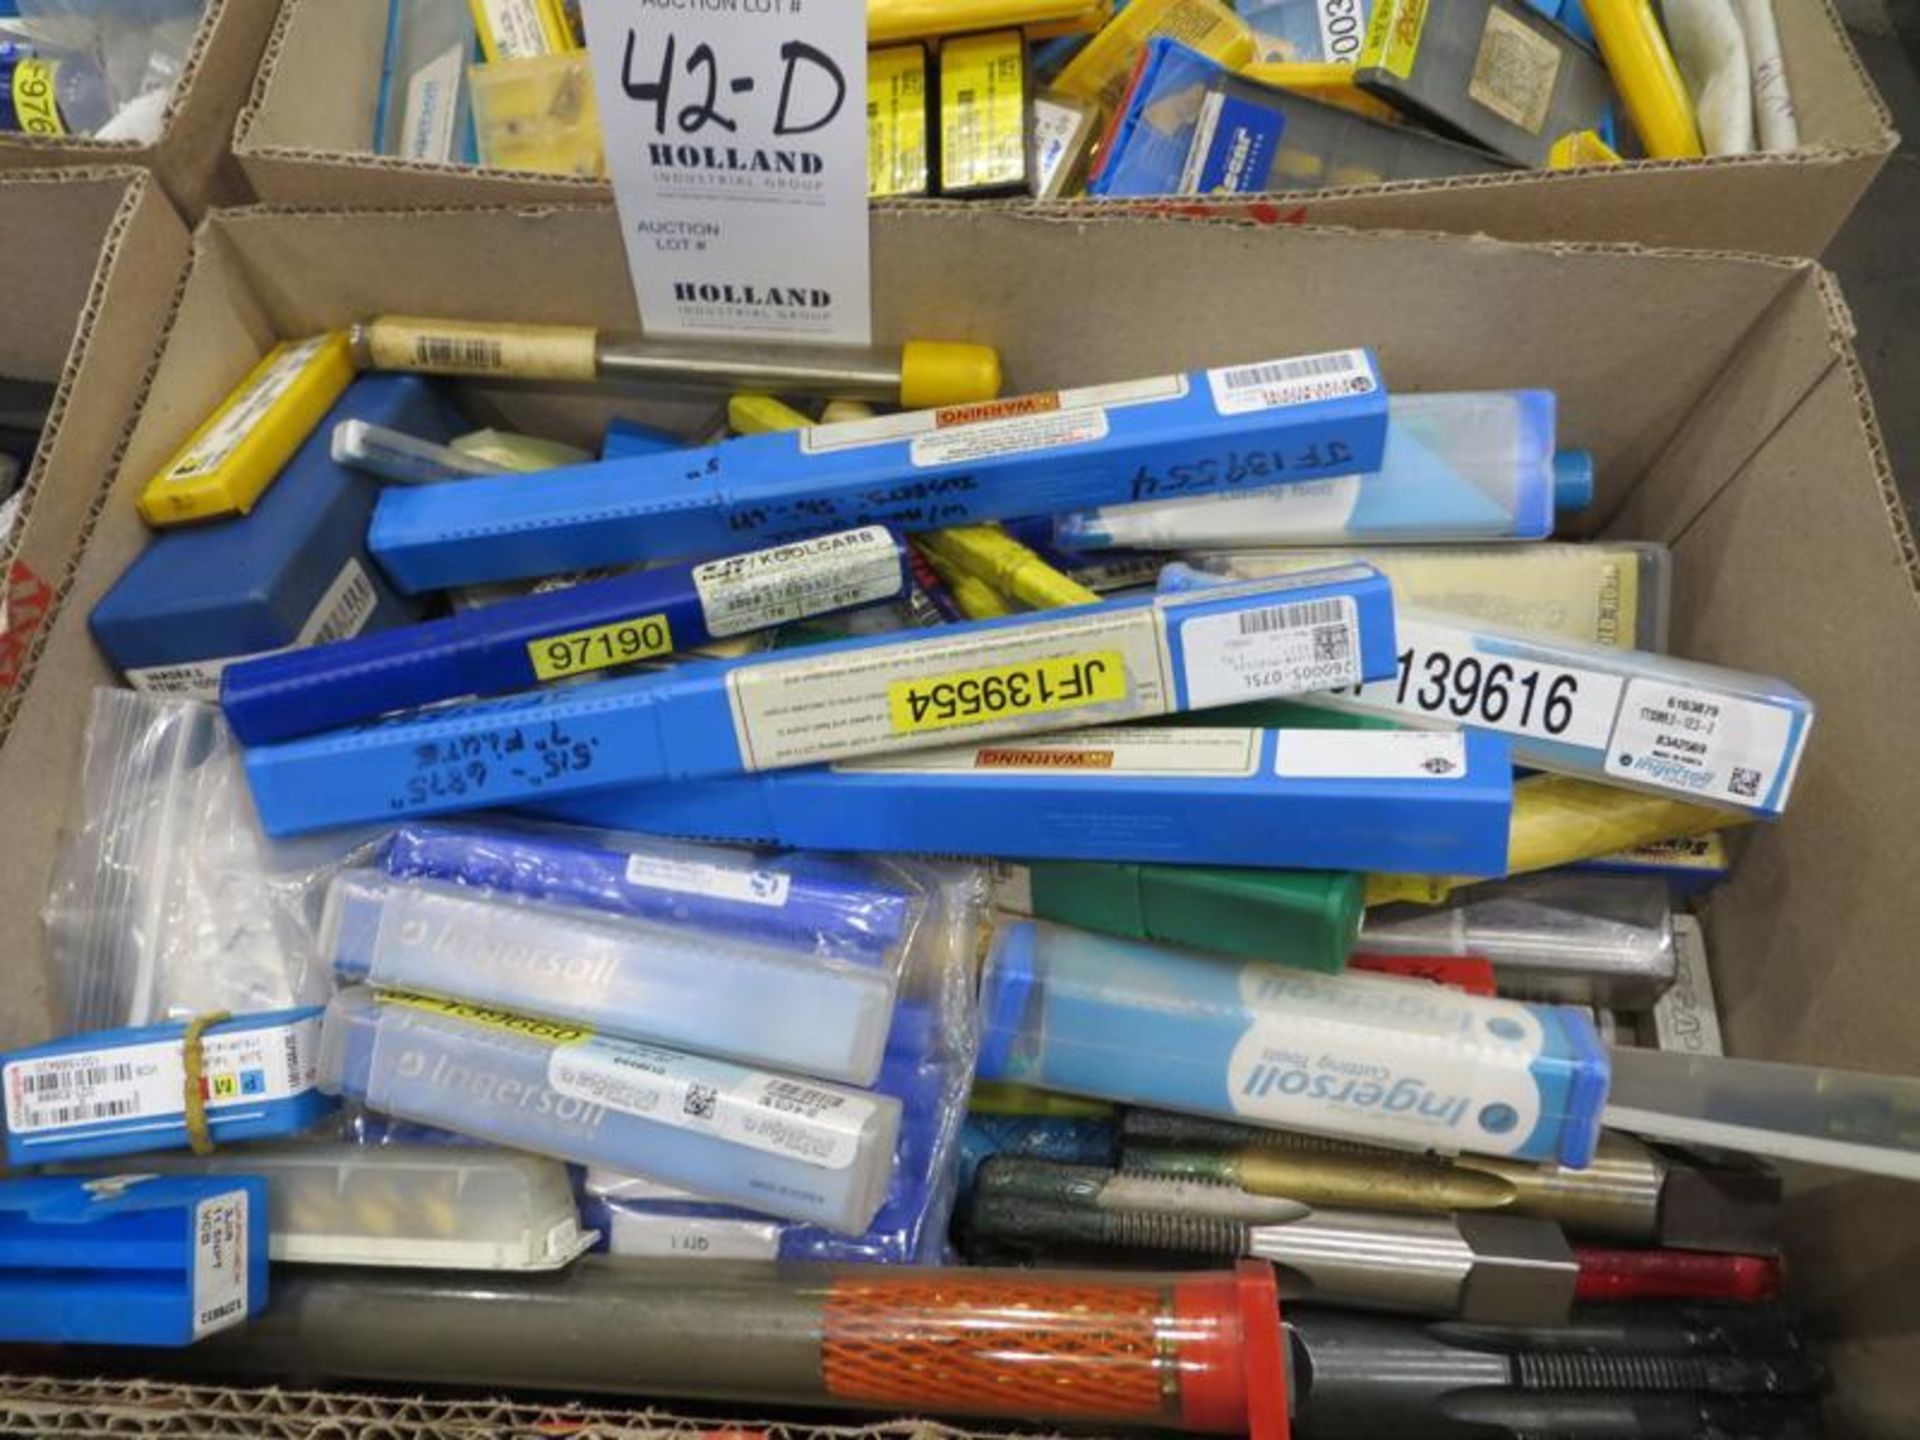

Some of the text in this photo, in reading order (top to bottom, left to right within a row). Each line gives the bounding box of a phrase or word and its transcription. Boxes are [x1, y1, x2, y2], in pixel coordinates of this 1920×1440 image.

[621, 28, 846, 136] 42-D
[648, 143, 823, 175] HOLLAND
[654, 172, 824, 192] INDUSTRIAL GROUP
[637, 220, 720, 237] AUCTION
[655, 237, 707, 251] LOT #
[673, 282, 832, 309] HOLLAND
[678, 304, 832, 322] INDUSTRIAL GROUP
[939, 400, 1037, 427] WARNING
[547, 622, 664, 671] 97190
[906, 659, 1106, 724] JF139554
[981, 751, 1085, 769] WARNING
[421, 1051, 606, 1129] Ingersoll
[1243, 1064, 1471, 1127] Ingersoll
